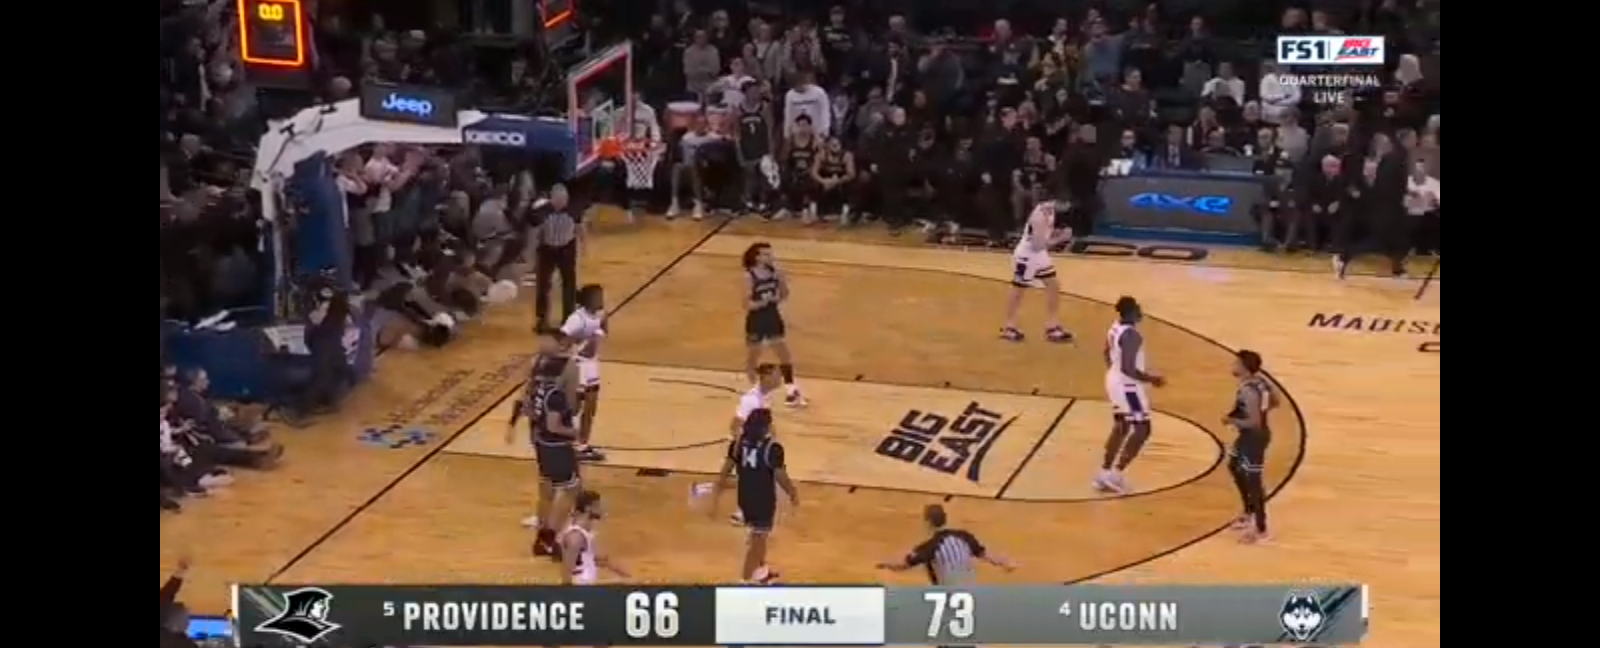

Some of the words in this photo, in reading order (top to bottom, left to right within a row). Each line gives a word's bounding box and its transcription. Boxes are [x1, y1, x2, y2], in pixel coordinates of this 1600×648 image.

[382, 93, 433, 117] Jeep
[465, 130, 526, 145] GEICO
[874, 409, 949, 462] BIG
[918, 401, 1002, 474] EAST
[741, 446, 757, 468] 14
